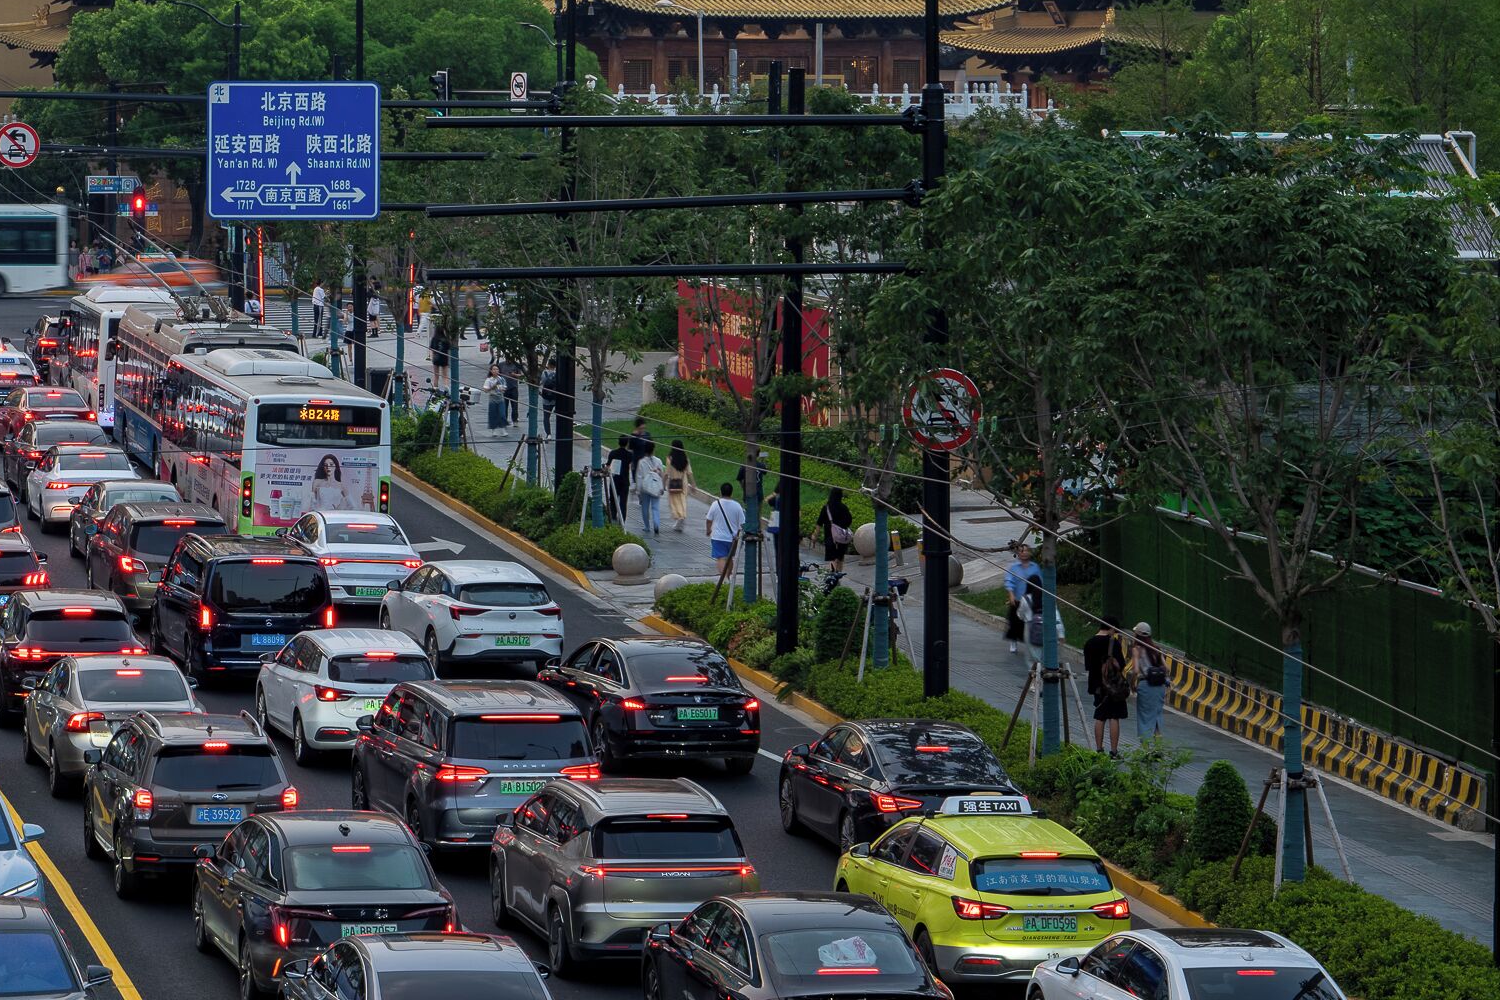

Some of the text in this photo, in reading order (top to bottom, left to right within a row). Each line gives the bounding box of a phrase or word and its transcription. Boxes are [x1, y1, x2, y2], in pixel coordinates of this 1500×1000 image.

[214, 86, 225, 96] 北
[261, 92, 327, 112] 北京西路
[263, 116, 296, 129] Beijing
[215, 134, 281, 154] 延安西路
[306, 134, 372, 154] 陕西北路
[218, 158, 249, 169] Yan'an
[307, 158, 344, 169] Shaanxi
[236, 180, 256, 190] 1728
[331, 180, 351, 190] 1688
[265, 188, 322, 203] 南京西路
[237, 200, 254, 210] 1717
[333, 200, 351, 210] 1661
